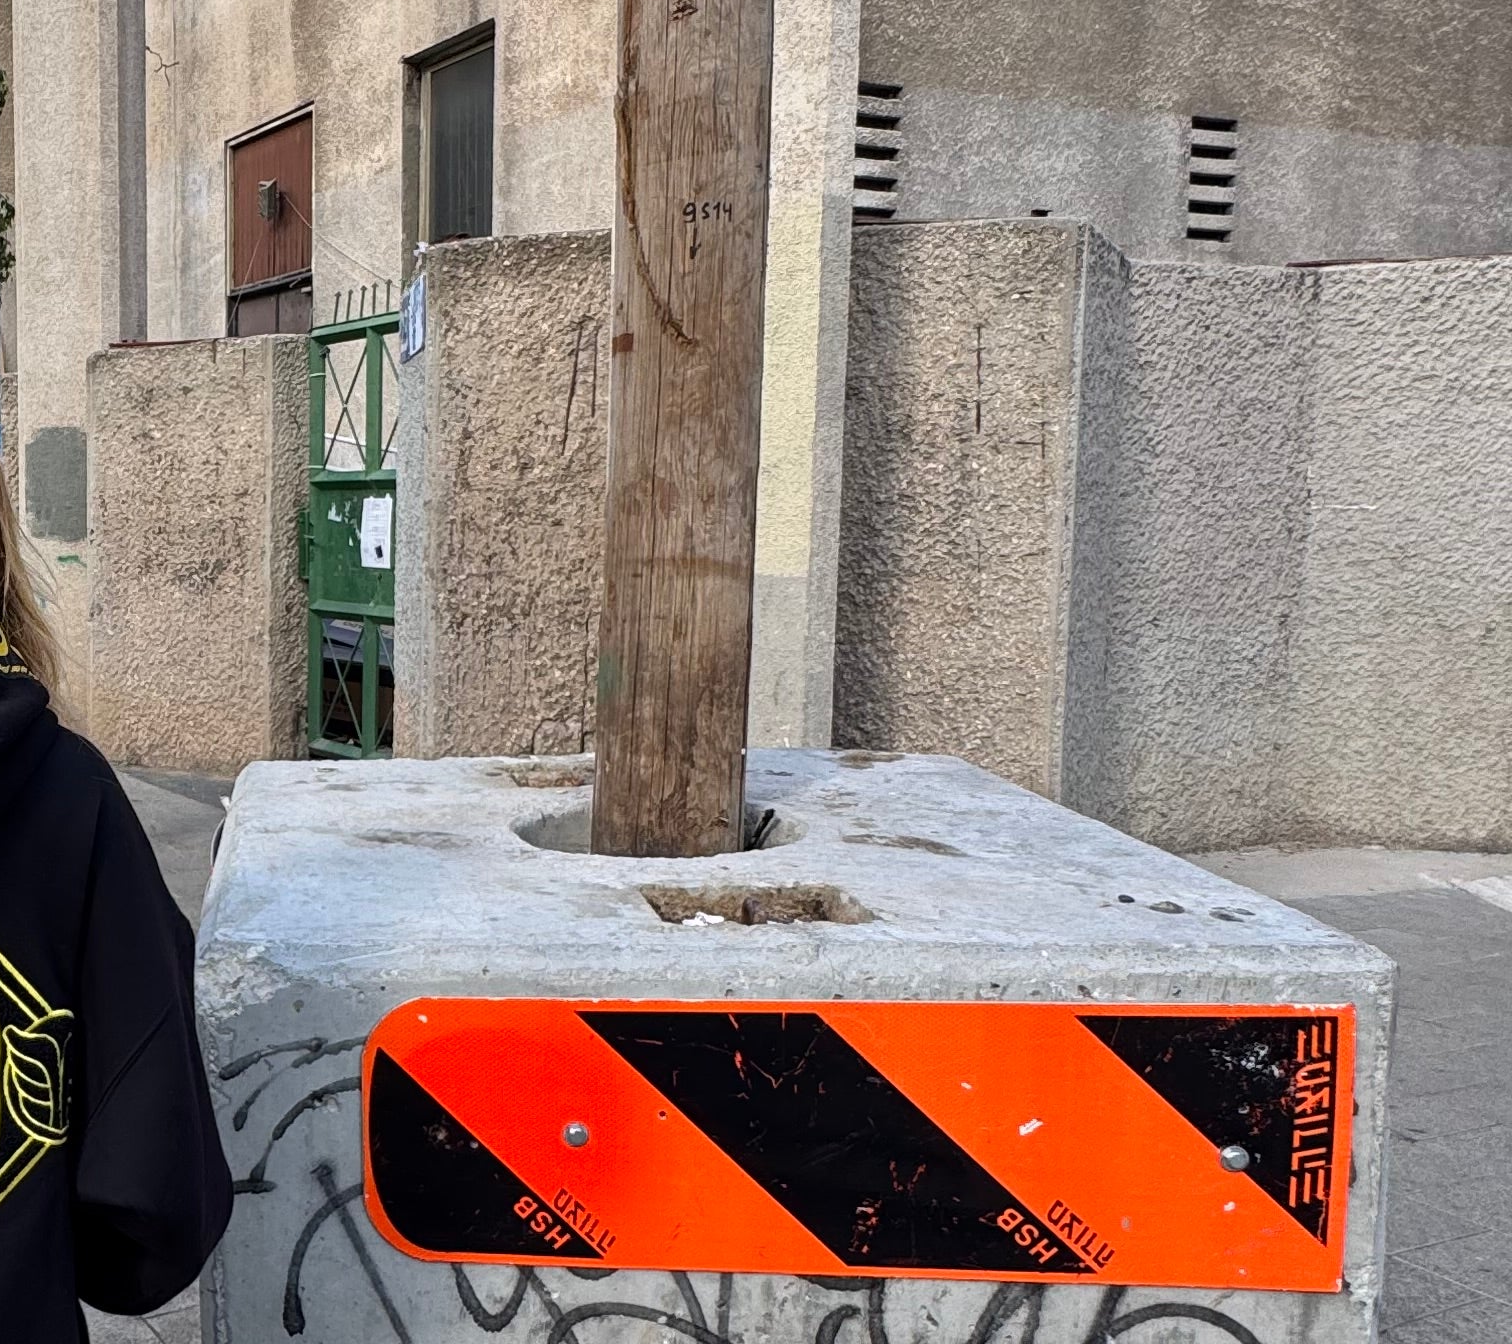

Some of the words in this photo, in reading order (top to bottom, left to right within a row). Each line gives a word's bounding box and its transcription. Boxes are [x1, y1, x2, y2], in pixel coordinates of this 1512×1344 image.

[1291, 1060, 1332, 1172] מצודה
[513, 1196, 572, 1251] HSB
[553, 1187, 617, 1255] מצודה
[996, 1207, 1059, 1264] HSB
[1047, 1199, 1116, 1269] מצודה
